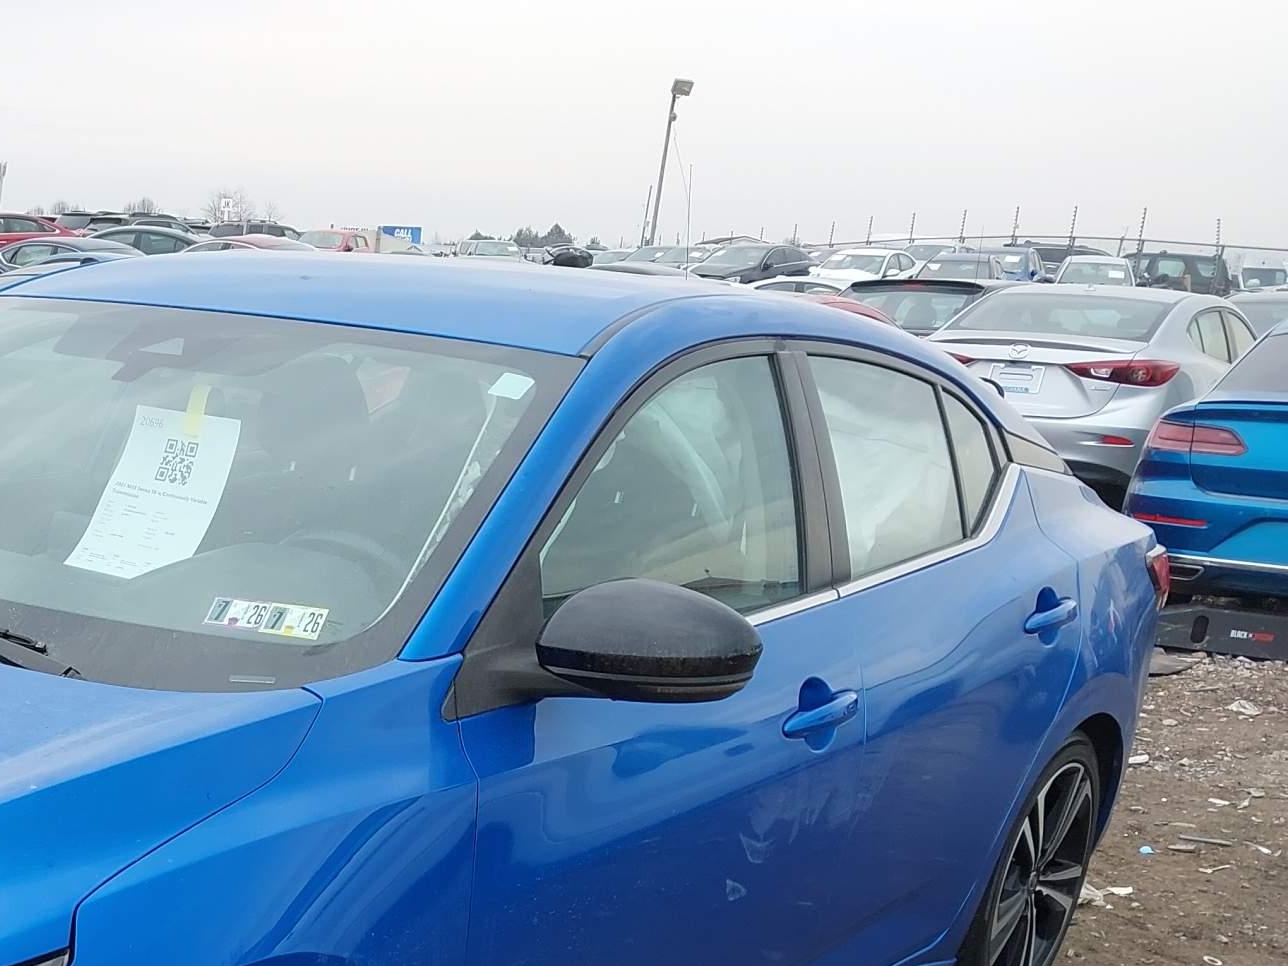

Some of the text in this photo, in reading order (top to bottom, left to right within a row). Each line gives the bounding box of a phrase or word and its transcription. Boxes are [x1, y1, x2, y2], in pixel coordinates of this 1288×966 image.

[213, 600, 268, 625] 7 26
[303, 611, 324, 633] 26
